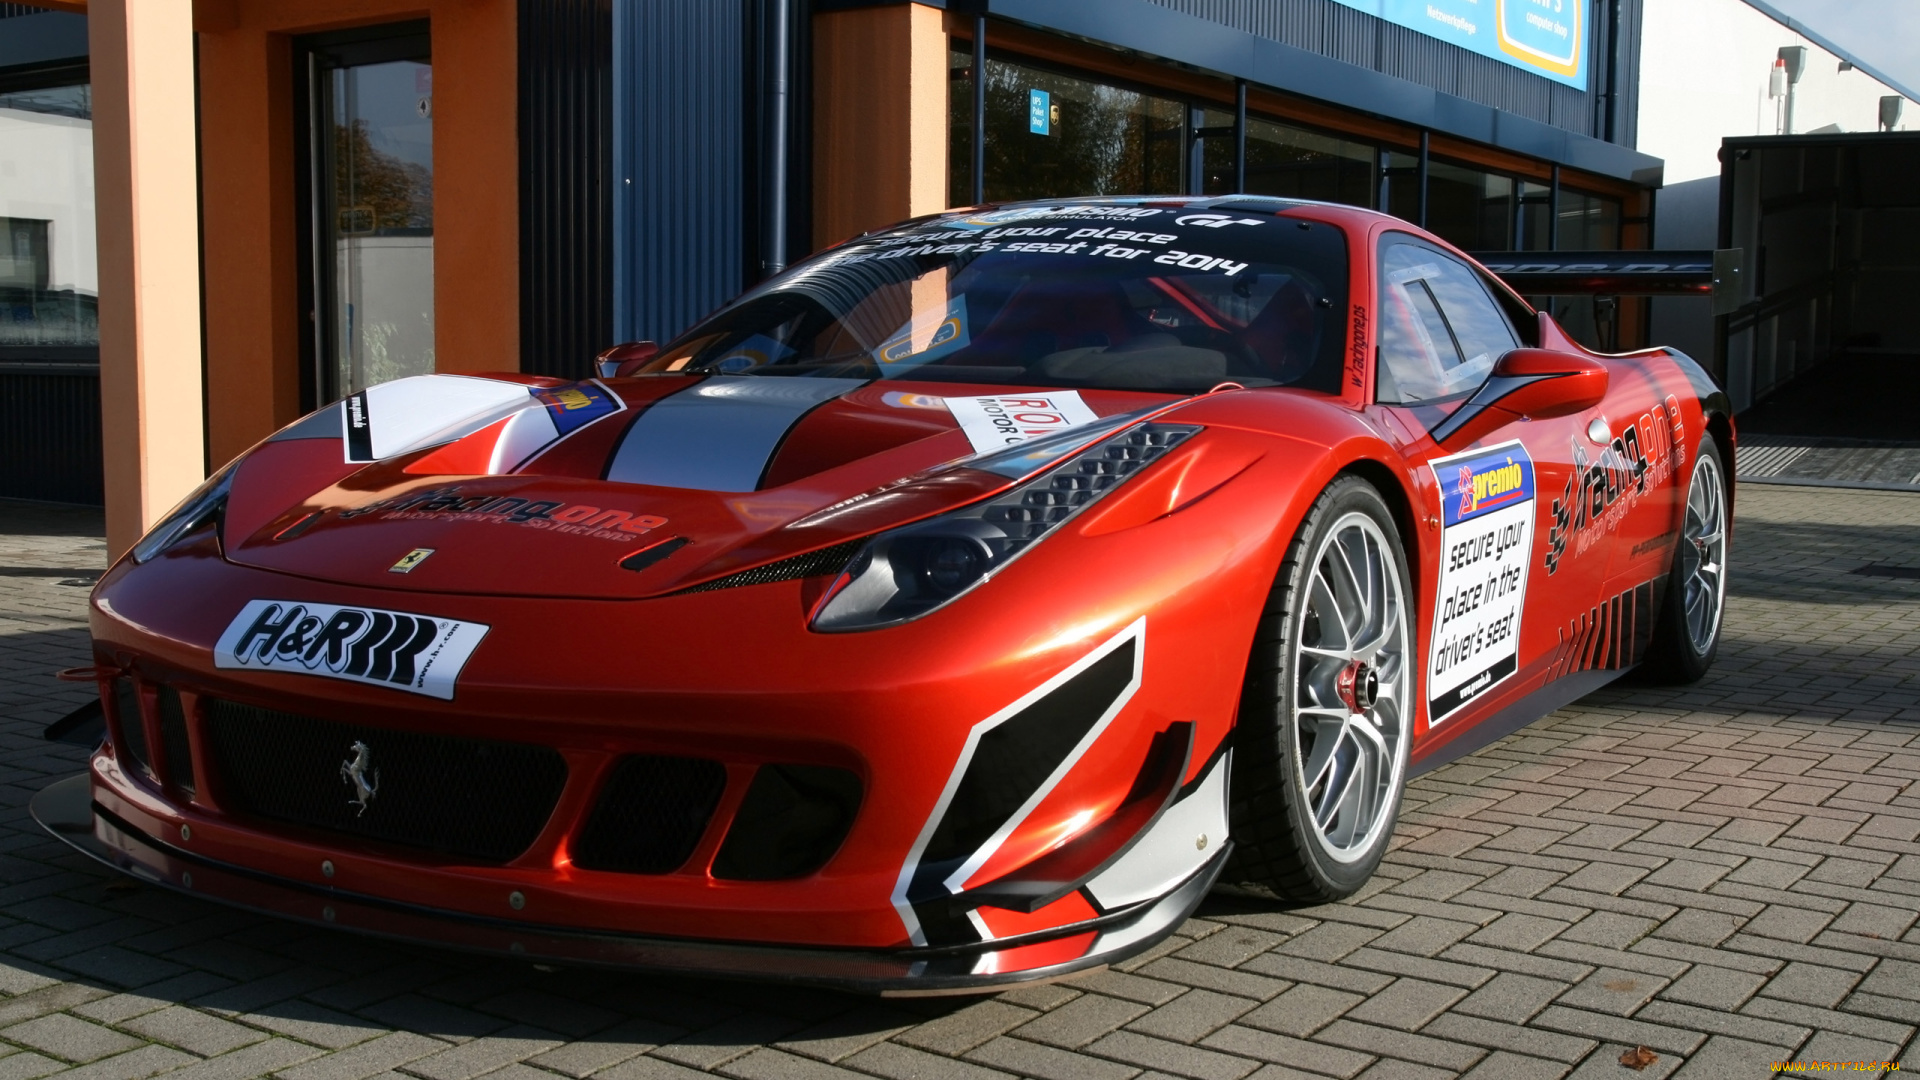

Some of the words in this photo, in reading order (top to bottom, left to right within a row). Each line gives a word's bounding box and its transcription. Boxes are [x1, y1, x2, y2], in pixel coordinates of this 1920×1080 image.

[1426, 4, 1477, 36] Netzwerkpflege
[1526, 11, 1553, 31] computer
[1553, 20, 1568, 40] shop
[877, 240, 1001, 261] driver's
[1000, 240, 1089, 256] seat
[1089, 243, 1151, 261] for
[1154, 249, 1250, 277] 2014
[981, 225, 1069, 243] your
[1069, 226, 1179, 246] place
[976, 398, 1018, 434] MOTOR
[1472, 456, 1523, 512] premio
[1449, 528, 1494, 574] secure
[1495, 519, 1526, 562] your
[1574, 485, 1638, 560] Motorsport
[1440, 579, 1483, 633] place
[1483, 569, 1497, 605] in
[1497, 563, 1521, 598] the
[234, 603, 371, 674] H&R
[417, 623, 461, 688] www.h-r.com
[1435, 621, 1484, 677] driver's
[1485, 604, 1515, 649] seat
